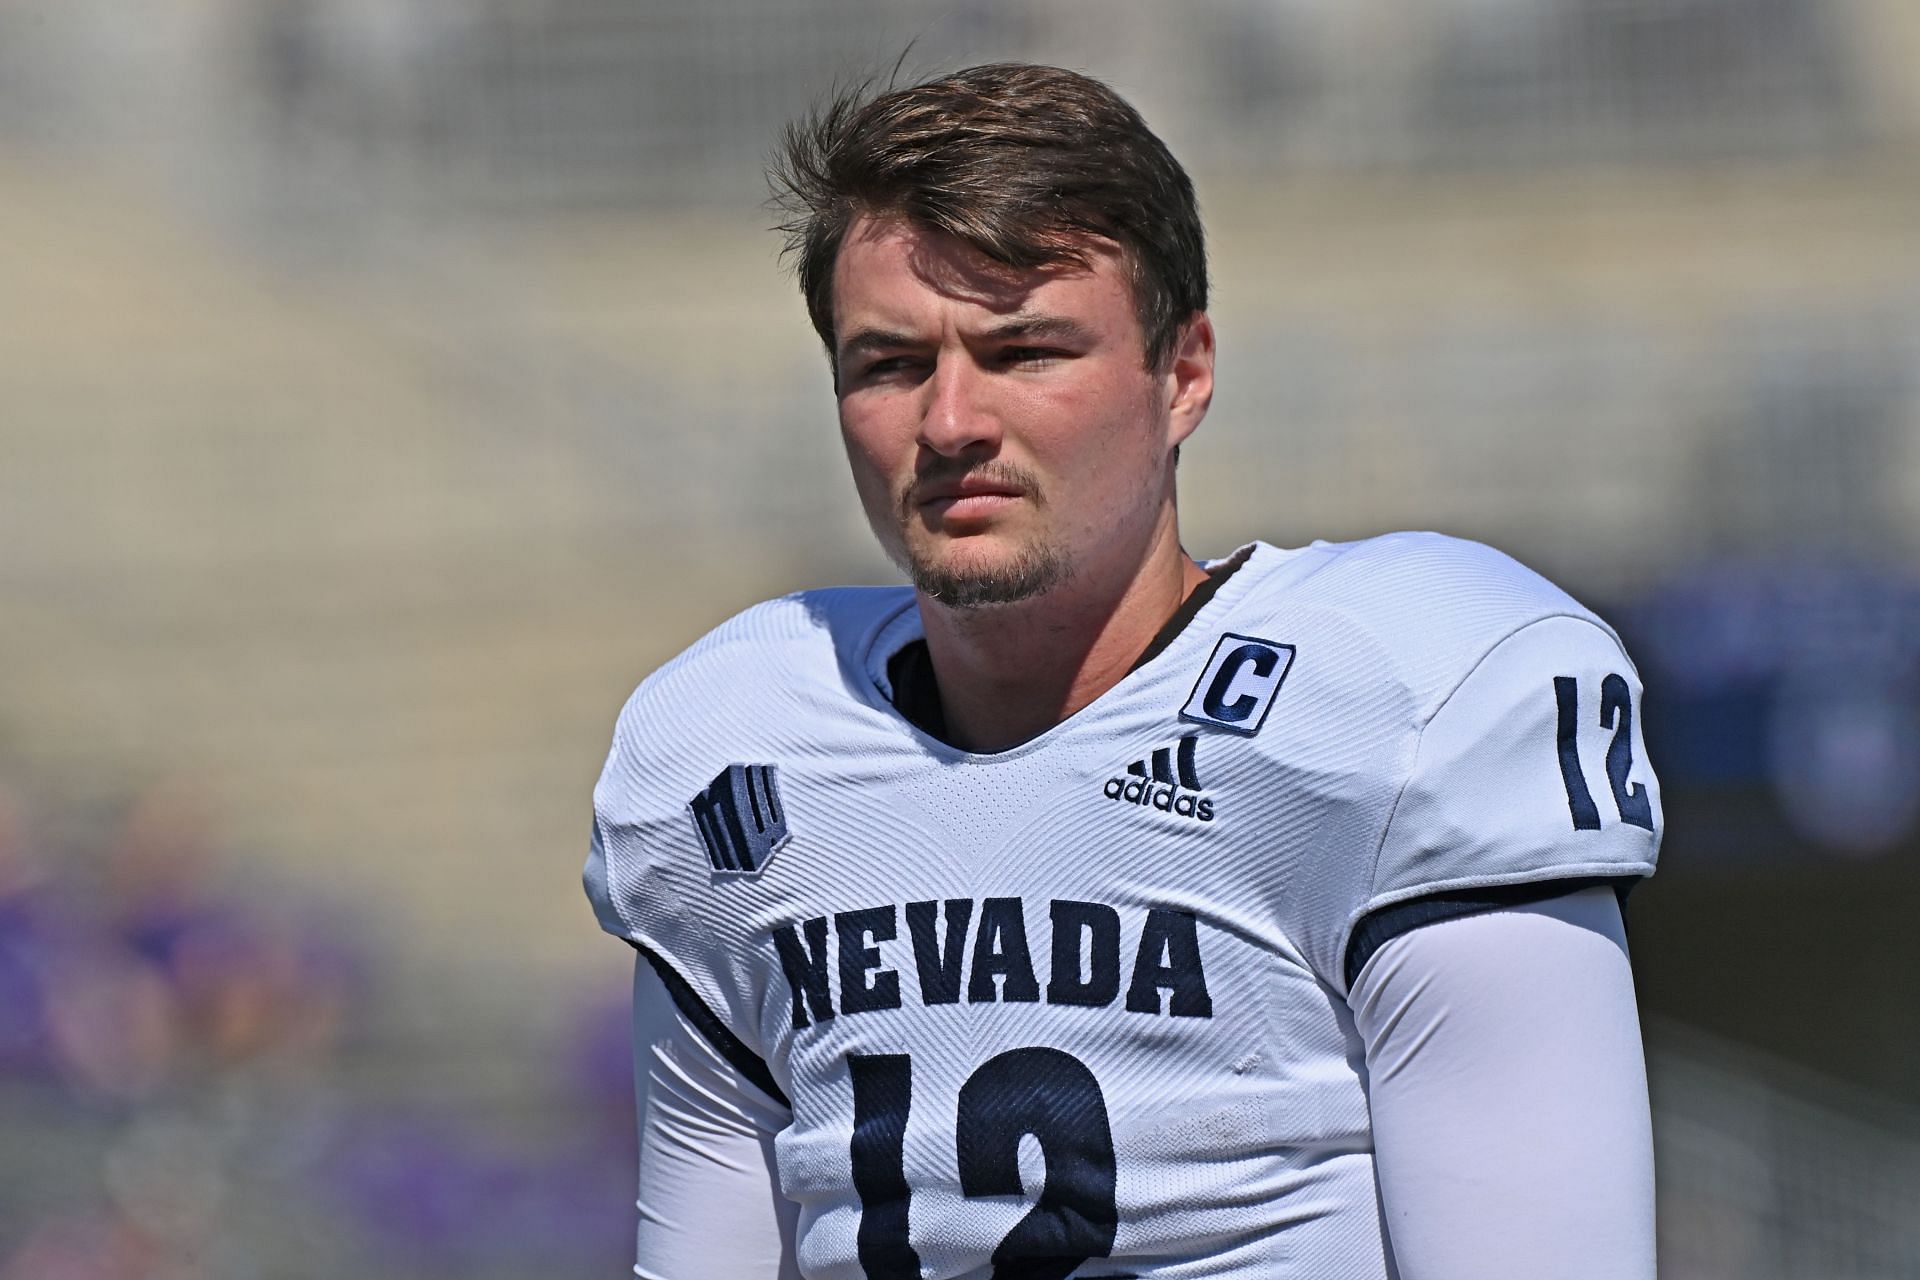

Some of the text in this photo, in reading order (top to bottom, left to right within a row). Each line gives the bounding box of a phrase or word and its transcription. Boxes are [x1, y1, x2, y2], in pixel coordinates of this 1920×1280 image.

[1203, 644, 1279, 722] C
[1103, 777, 1215, 821] adidas
[1553, 673, 1654, 832] 12
[774, 897, 1213, 1029] NEVADA
[847, 1046, 1139, 1280] 12
